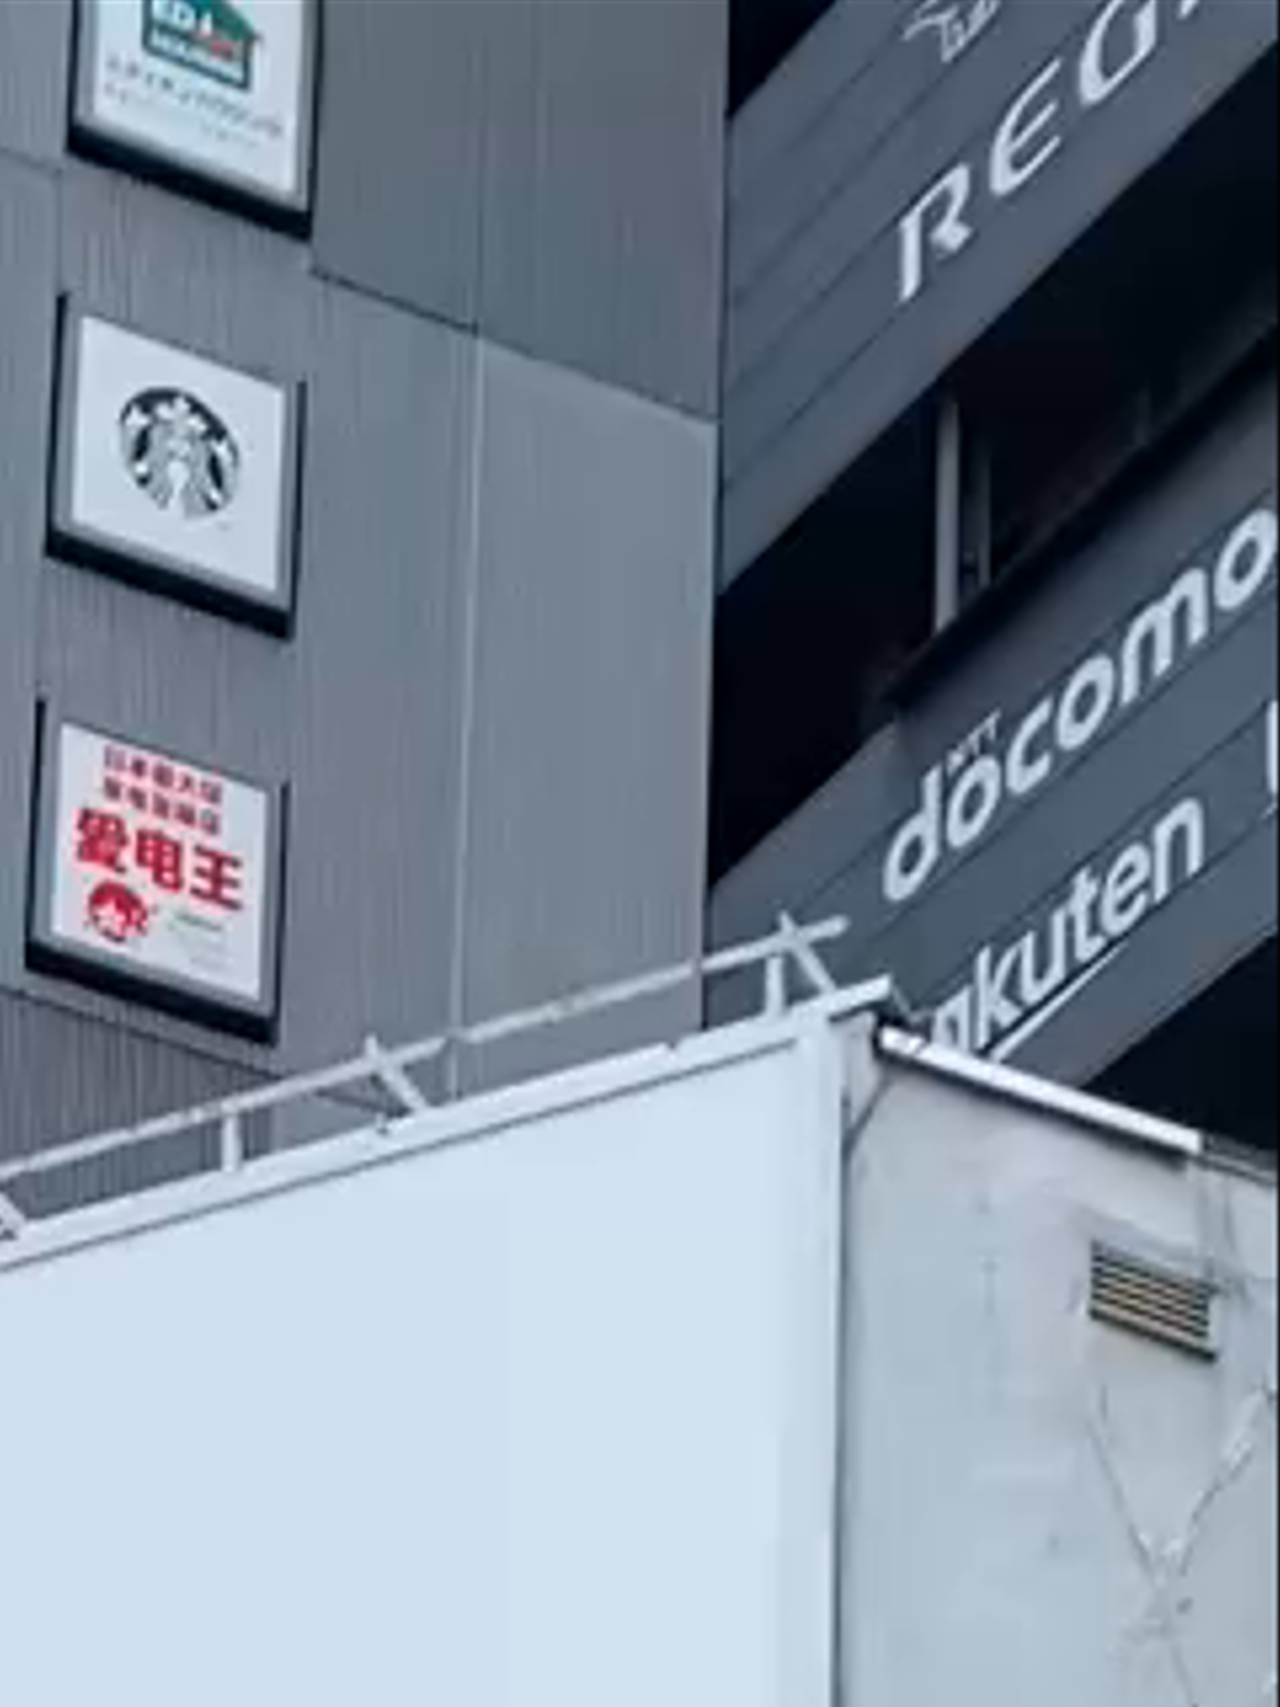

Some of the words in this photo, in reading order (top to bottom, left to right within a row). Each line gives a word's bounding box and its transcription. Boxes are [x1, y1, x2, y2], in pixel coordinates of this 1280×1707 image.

[898, 0, 1200, 303] REG
[884, 508, 1278, 902] docomo
[930, 798, 1204, 1052] akuten
